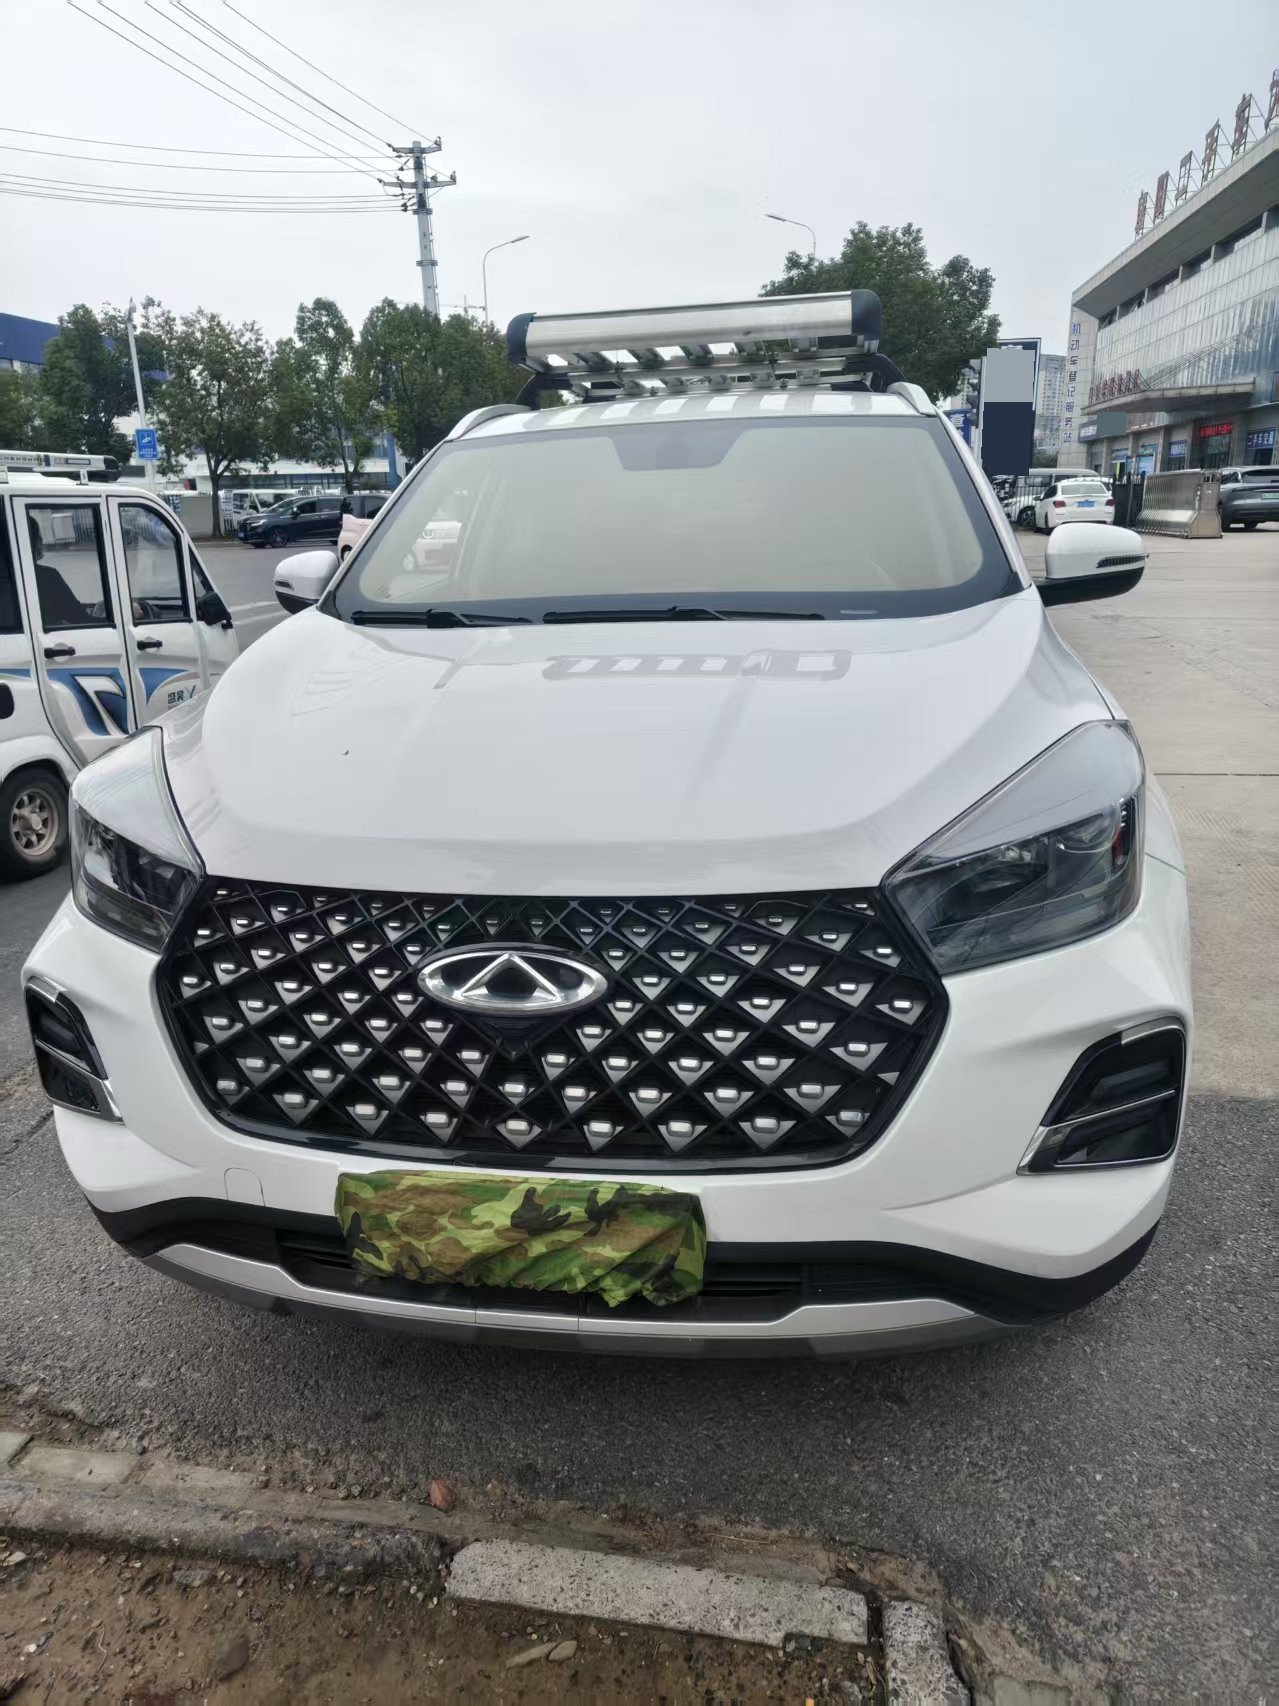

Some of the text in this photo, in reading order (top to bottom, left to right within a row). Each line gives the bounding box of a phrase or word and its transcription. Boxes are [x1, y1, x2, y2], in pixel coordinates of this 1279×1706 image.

[1063, 323, 1081, 443] 机动车登记服务站
